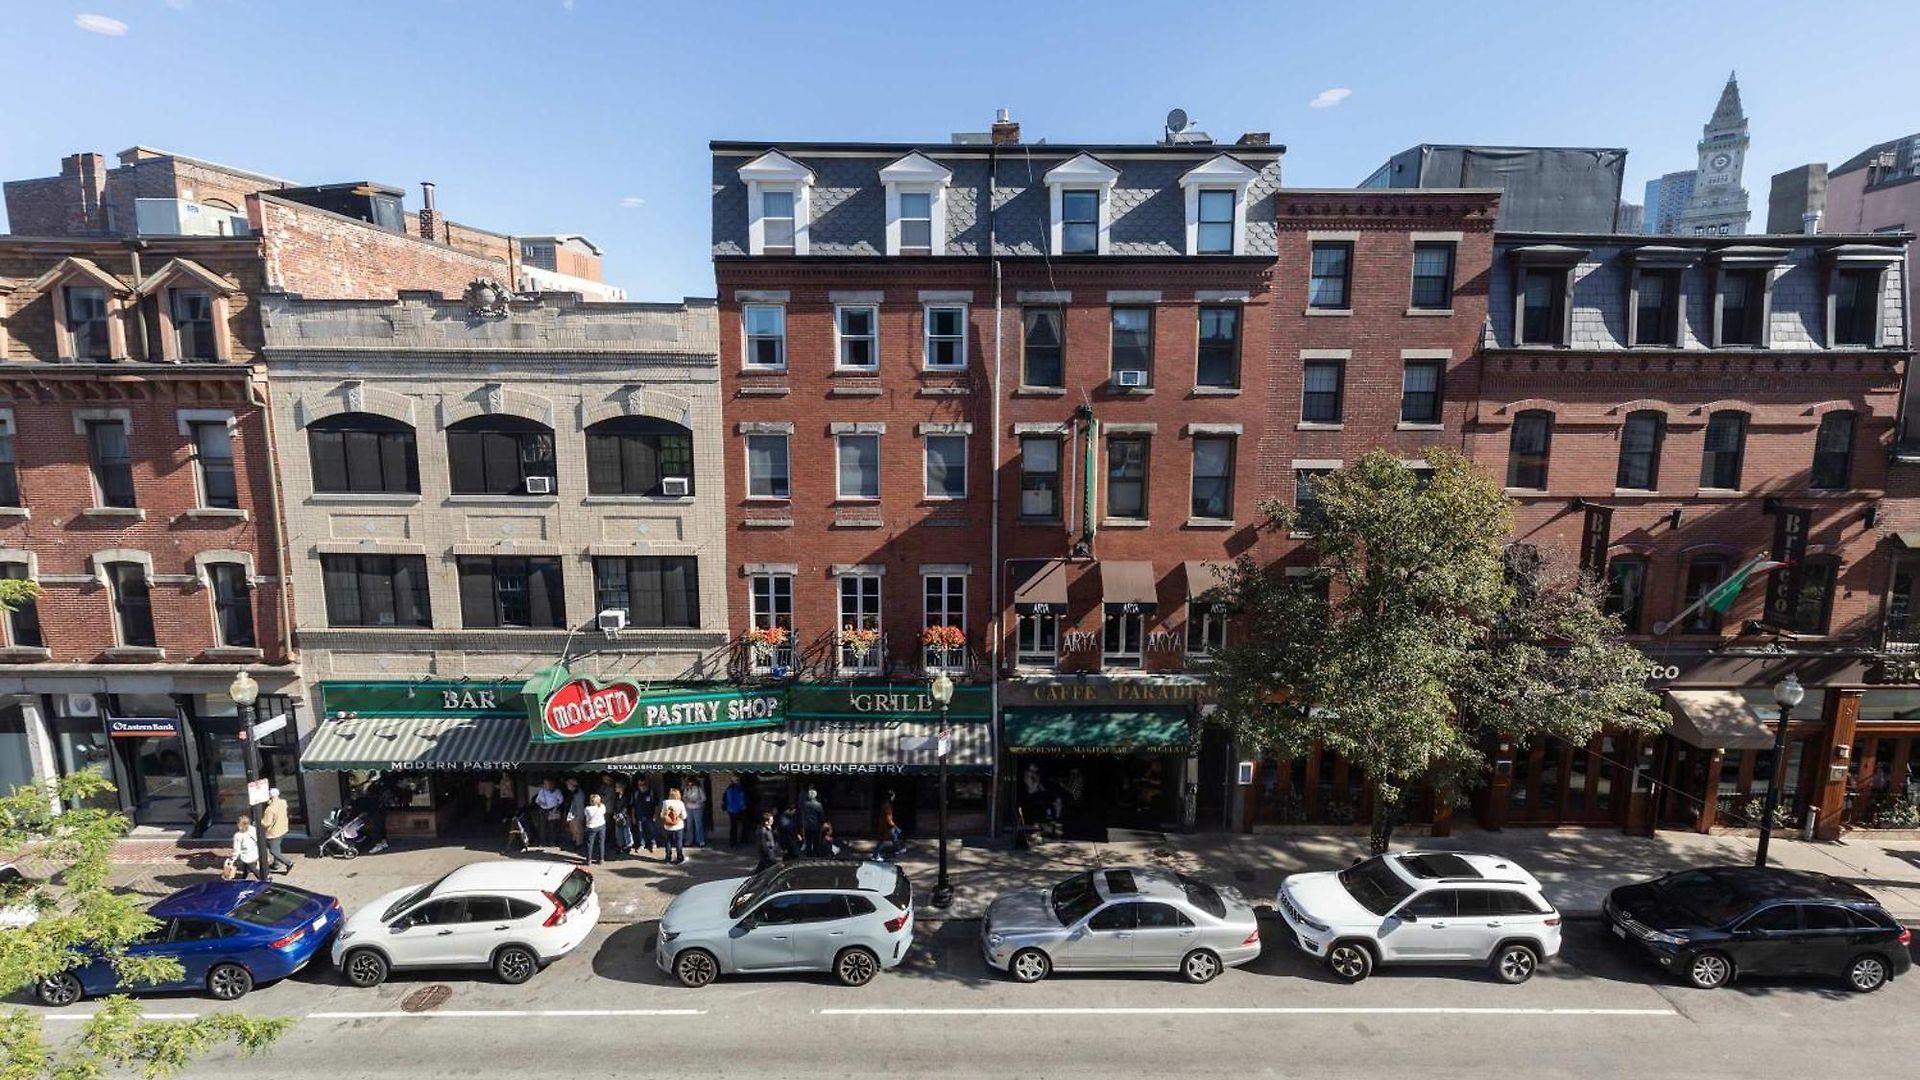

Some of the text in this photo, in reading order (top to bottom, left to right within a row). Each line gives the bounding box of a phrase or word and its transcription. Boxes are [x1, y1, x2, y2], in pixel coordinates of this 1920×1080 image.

[1032, 603, 1050, 614] ARYA
[1122, 603, 1140, 614] ARYA
[1063, 631, 1098, 652] ARYA
[1147, 631, 1182, 652] ARYA
[442, 690, 497, 709] BAR
[552, 681, 630, 730] modern
[854, 694, 933, 712] GRILL
[646, 696, 778, 726] PASTRY SHOP
[391, 761, 520, 770] MODERN PASTRY
[778, 763, 905, 773] MODERN PASTRY
